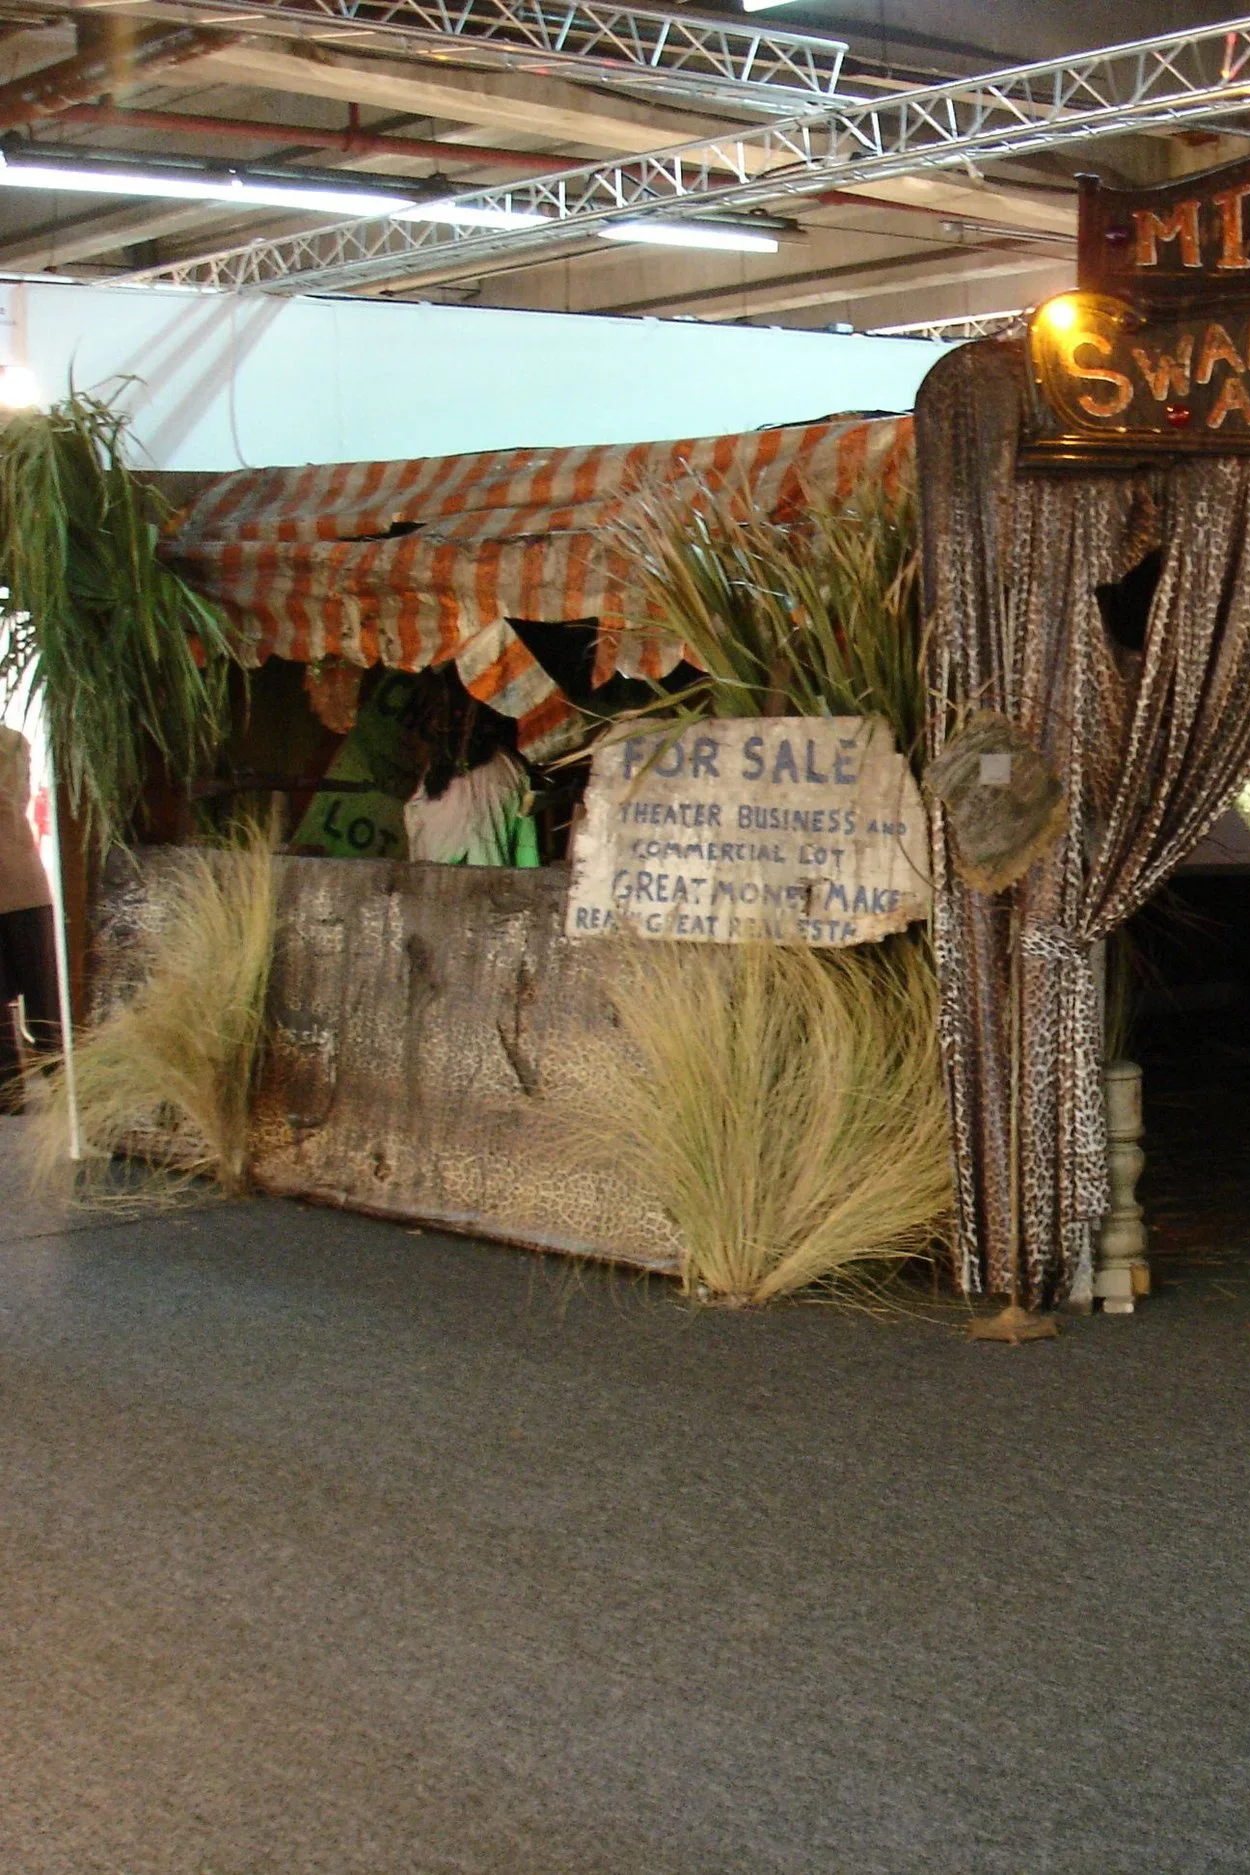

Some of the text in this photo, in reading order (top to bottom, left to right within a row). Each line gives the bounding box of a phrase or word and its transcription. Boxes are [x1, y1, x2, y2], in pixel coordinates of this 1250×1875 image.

[622, 735, 857, 785] FOR SALE
[619, 802, 907, 836] THEATER BUSINESS AND
[632, 838, 845, 866] COMMERCIAL LOT
[611, 869, 707, 905] GREAT
[645, 912, 718, 936] GEAT
